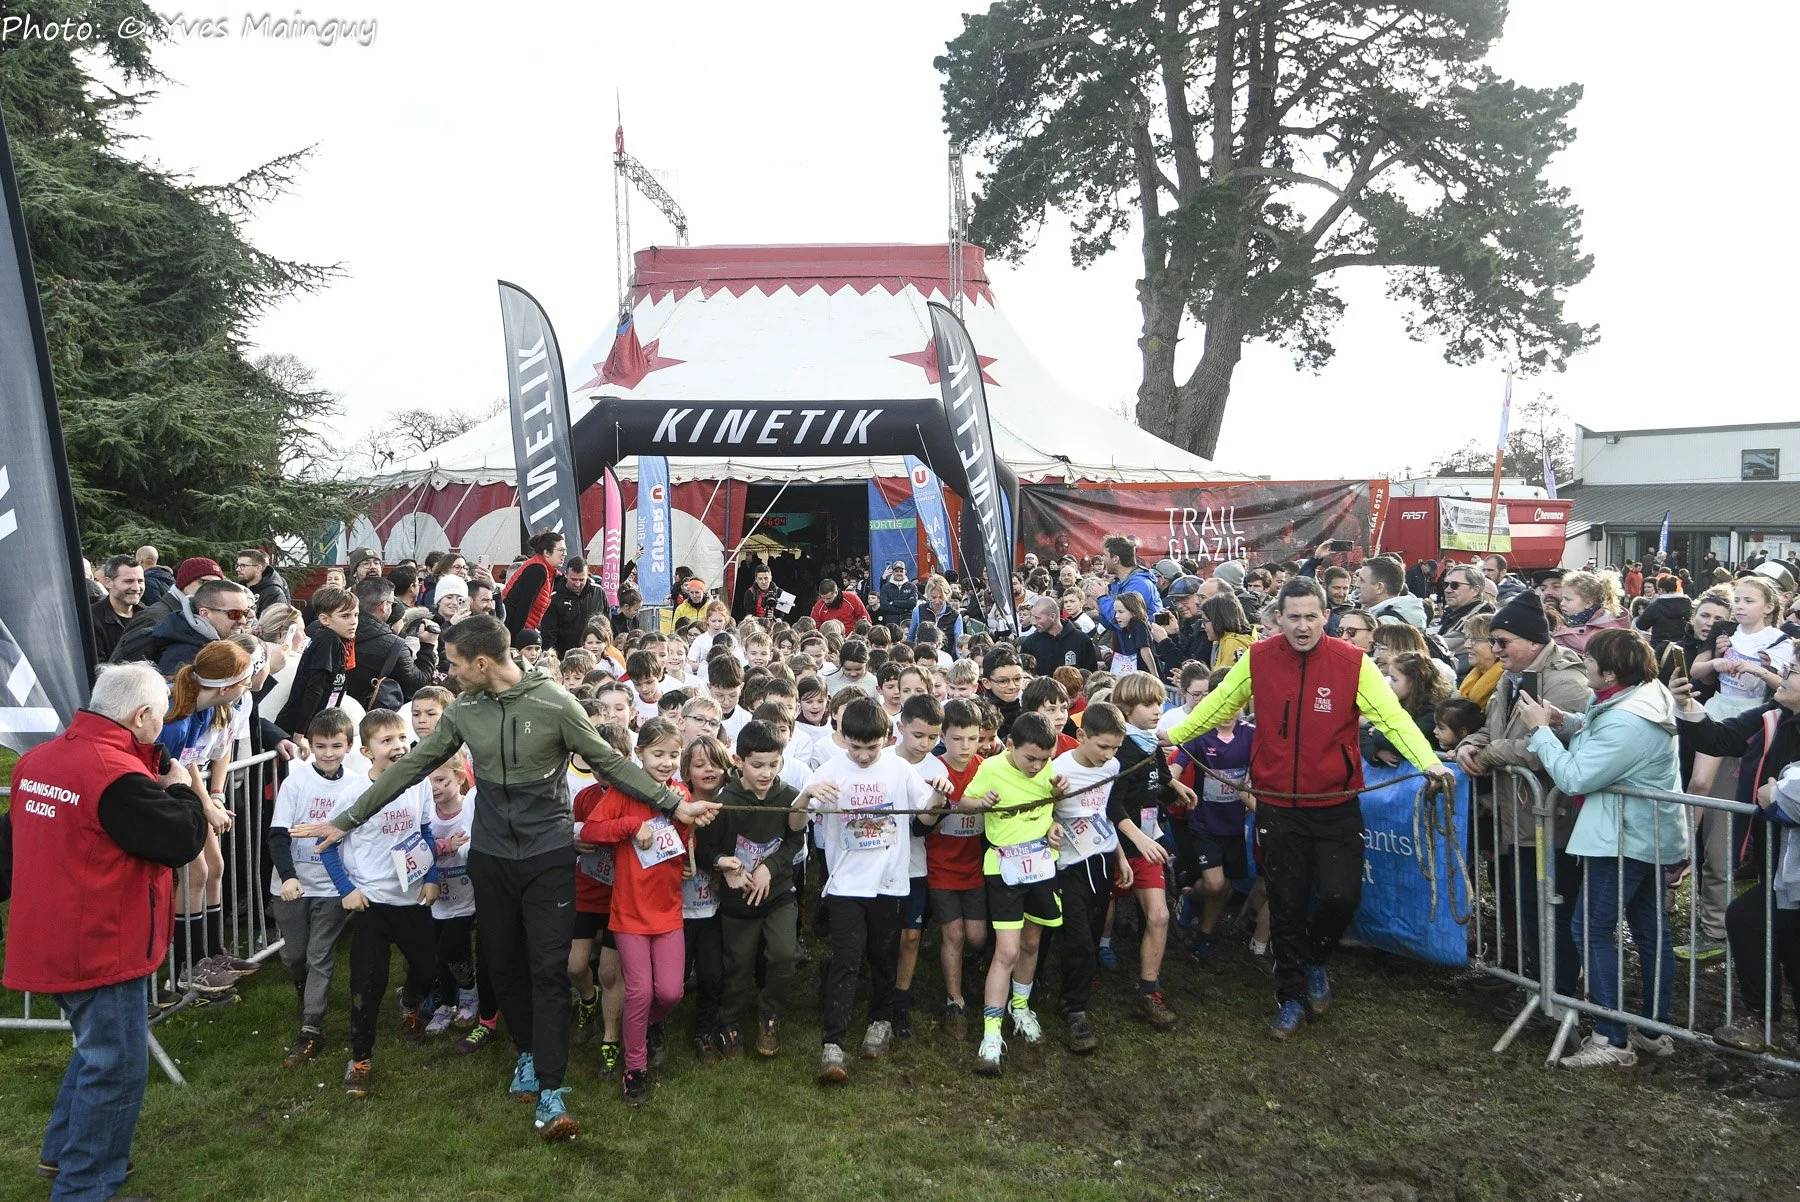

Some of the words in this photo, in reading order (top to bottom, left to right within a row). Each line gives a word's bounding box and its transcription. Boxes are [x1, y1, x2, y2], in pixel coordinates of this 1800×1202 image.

[652, 408, 884, 446] KINETIK
[1164, 506, 1245, 537] TRAIL
[1534, 507, 1564, 522] Chevance
[869, 519, 904, 530] SORTIE
[1168, 537, 1247, 562] GLAZIG
[853, 783, 881, 793] TRAIL
[850, 795, 883, 806] GLAZIG
[1080, 797, 1106, 807] GLAZIG
[25, 799, 56, 818] GLAZIG
[383, 808, 410, 822] TRAIL
[382, 819, 414, 835] GLAZIG
[960, 815, 976, 829] 119
[1070, 817, 1089, 835] 115
[656, 833, 675, 850] 28
[858, 839, 881, 847] SUPER
[1363, 828, 1413, 856] ants
[600, 851, 611, 860] ZIG
[1005, 847, 1029, 858] GLAZIG
[597, 861, 611, 876] 58
[1021, 859, 1032, 874] 17
[1362, 859, 1375, 885] t
[1017, 873, 1038, 882] SUPER
